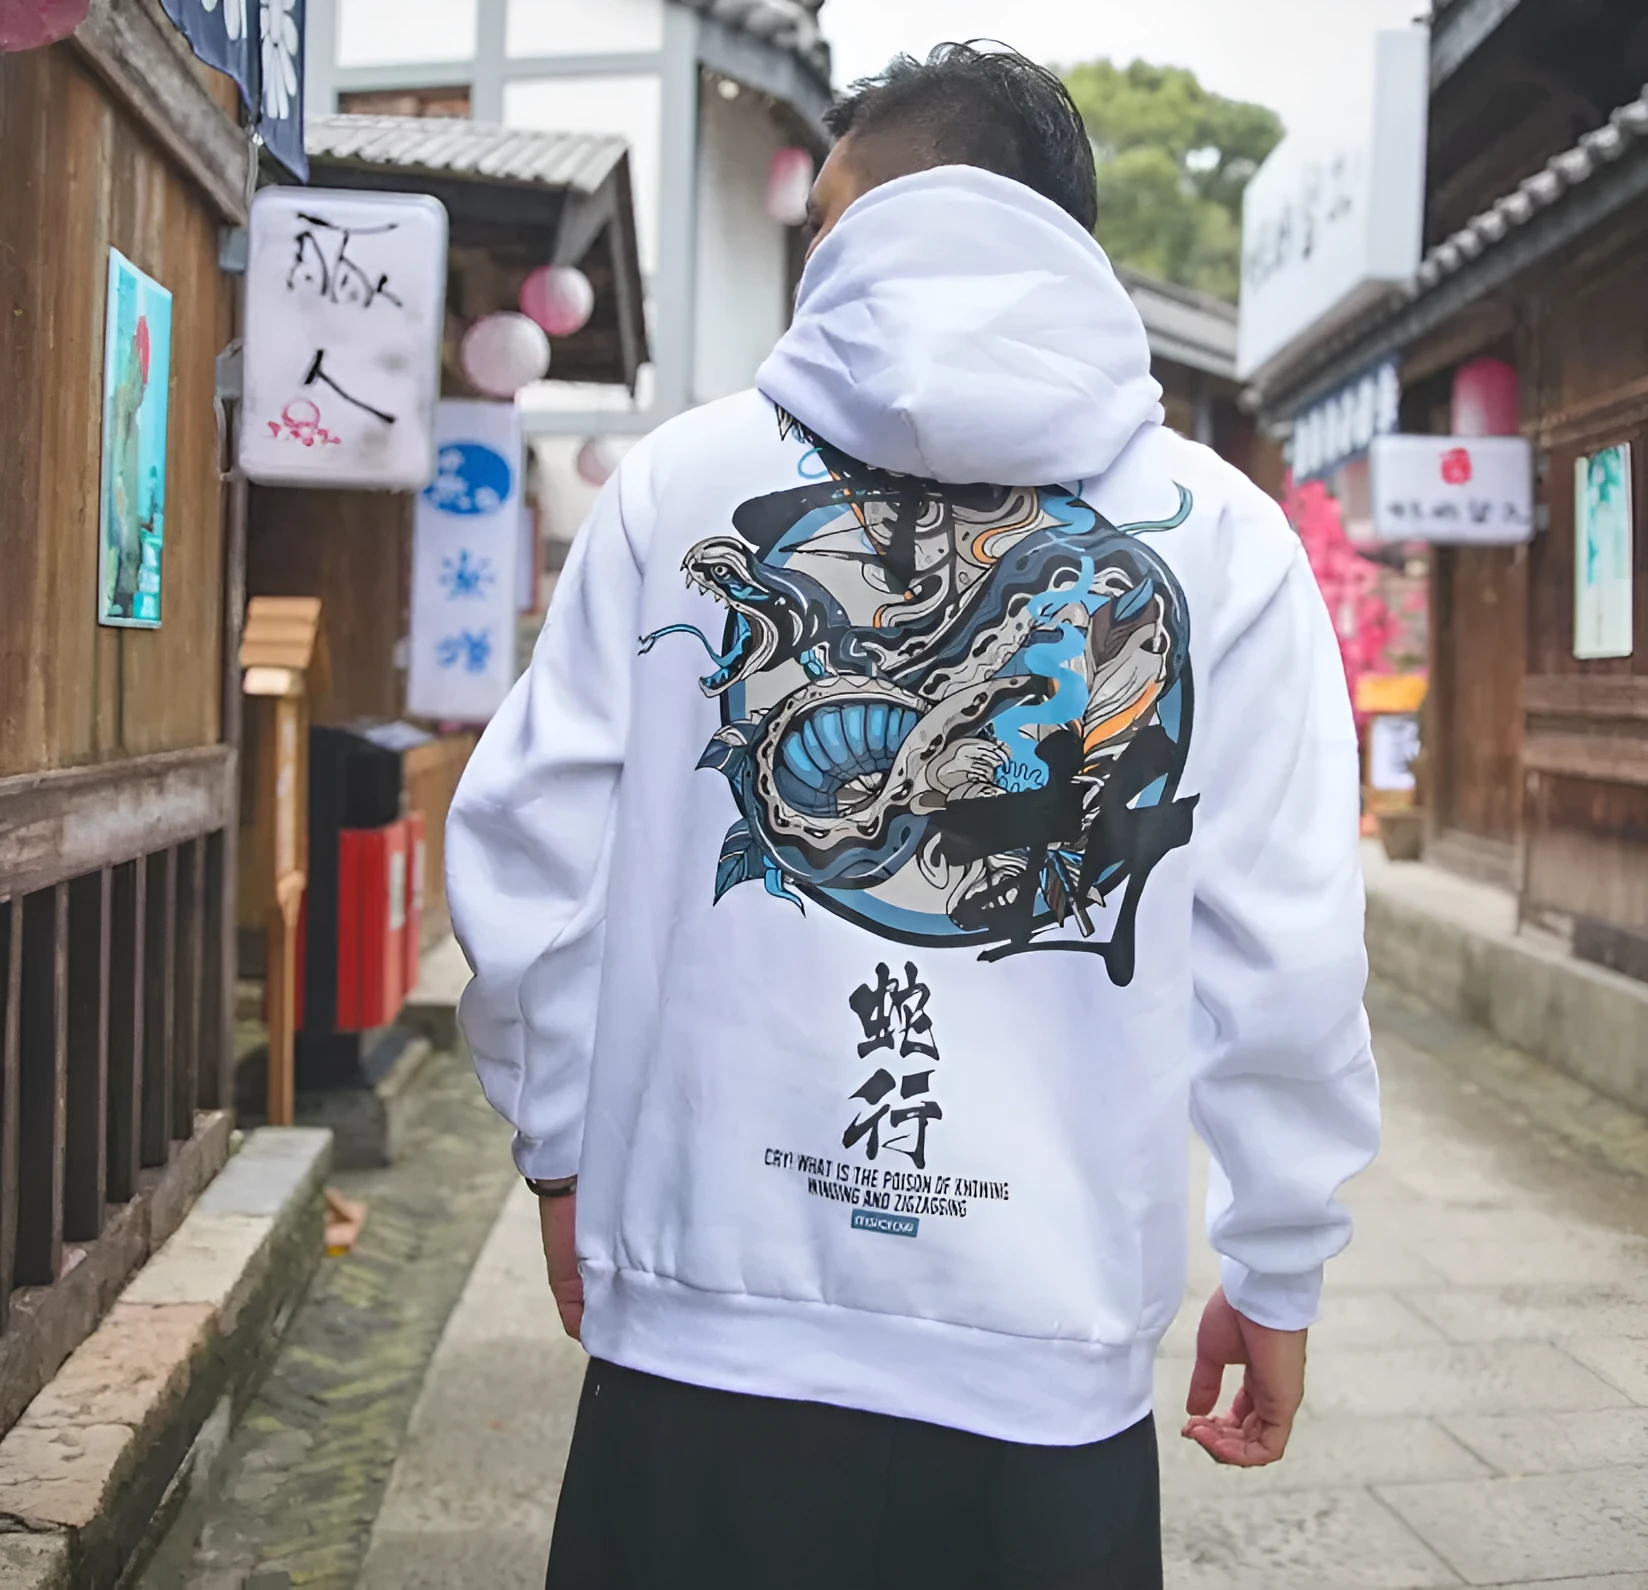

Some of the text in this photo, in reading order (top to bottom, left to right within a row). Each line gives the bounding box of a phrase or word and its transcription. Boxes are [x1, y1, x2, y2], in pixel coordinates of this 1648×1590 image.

[798, 1154, 832, 1177] WHAT
[836, 1163, 850, 1181] IS
[854, 1166, 879, 1188] THE
[883, 1170, 932, 1194] POISON
[934, 1175, 951, 1195] OF
[863, 1190, 890, 1210] AND
